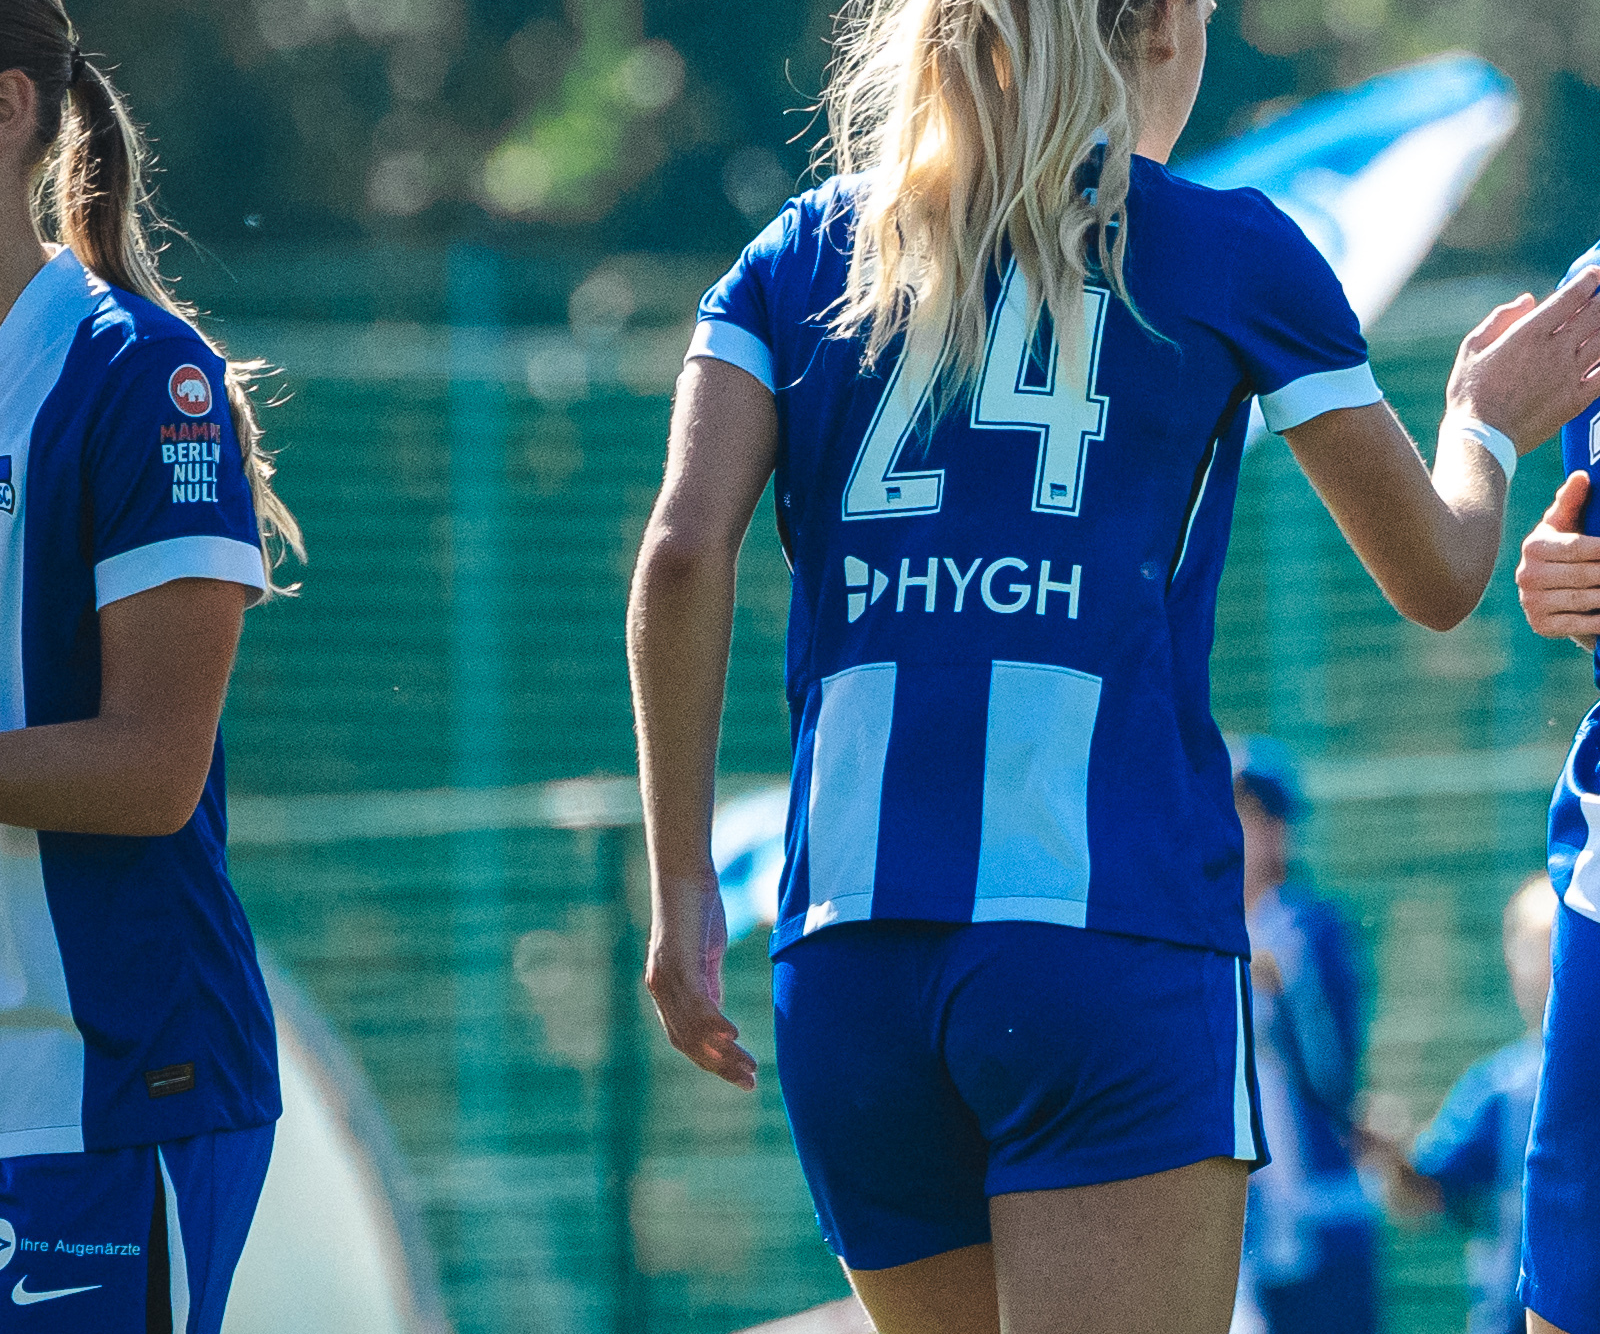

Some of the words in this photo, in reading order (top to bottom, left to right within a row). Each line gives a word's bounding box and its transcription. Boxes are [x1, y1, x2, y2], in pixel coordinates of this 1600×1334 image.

[173, 462, 217, 483] NULL
[172, 482, 218, 504] NULL
[896, 556, 1082, 620] HYGH
[20, 1237, 49, 1252] Ihre
[54, 1239, 141, 1257] Augenärzte
